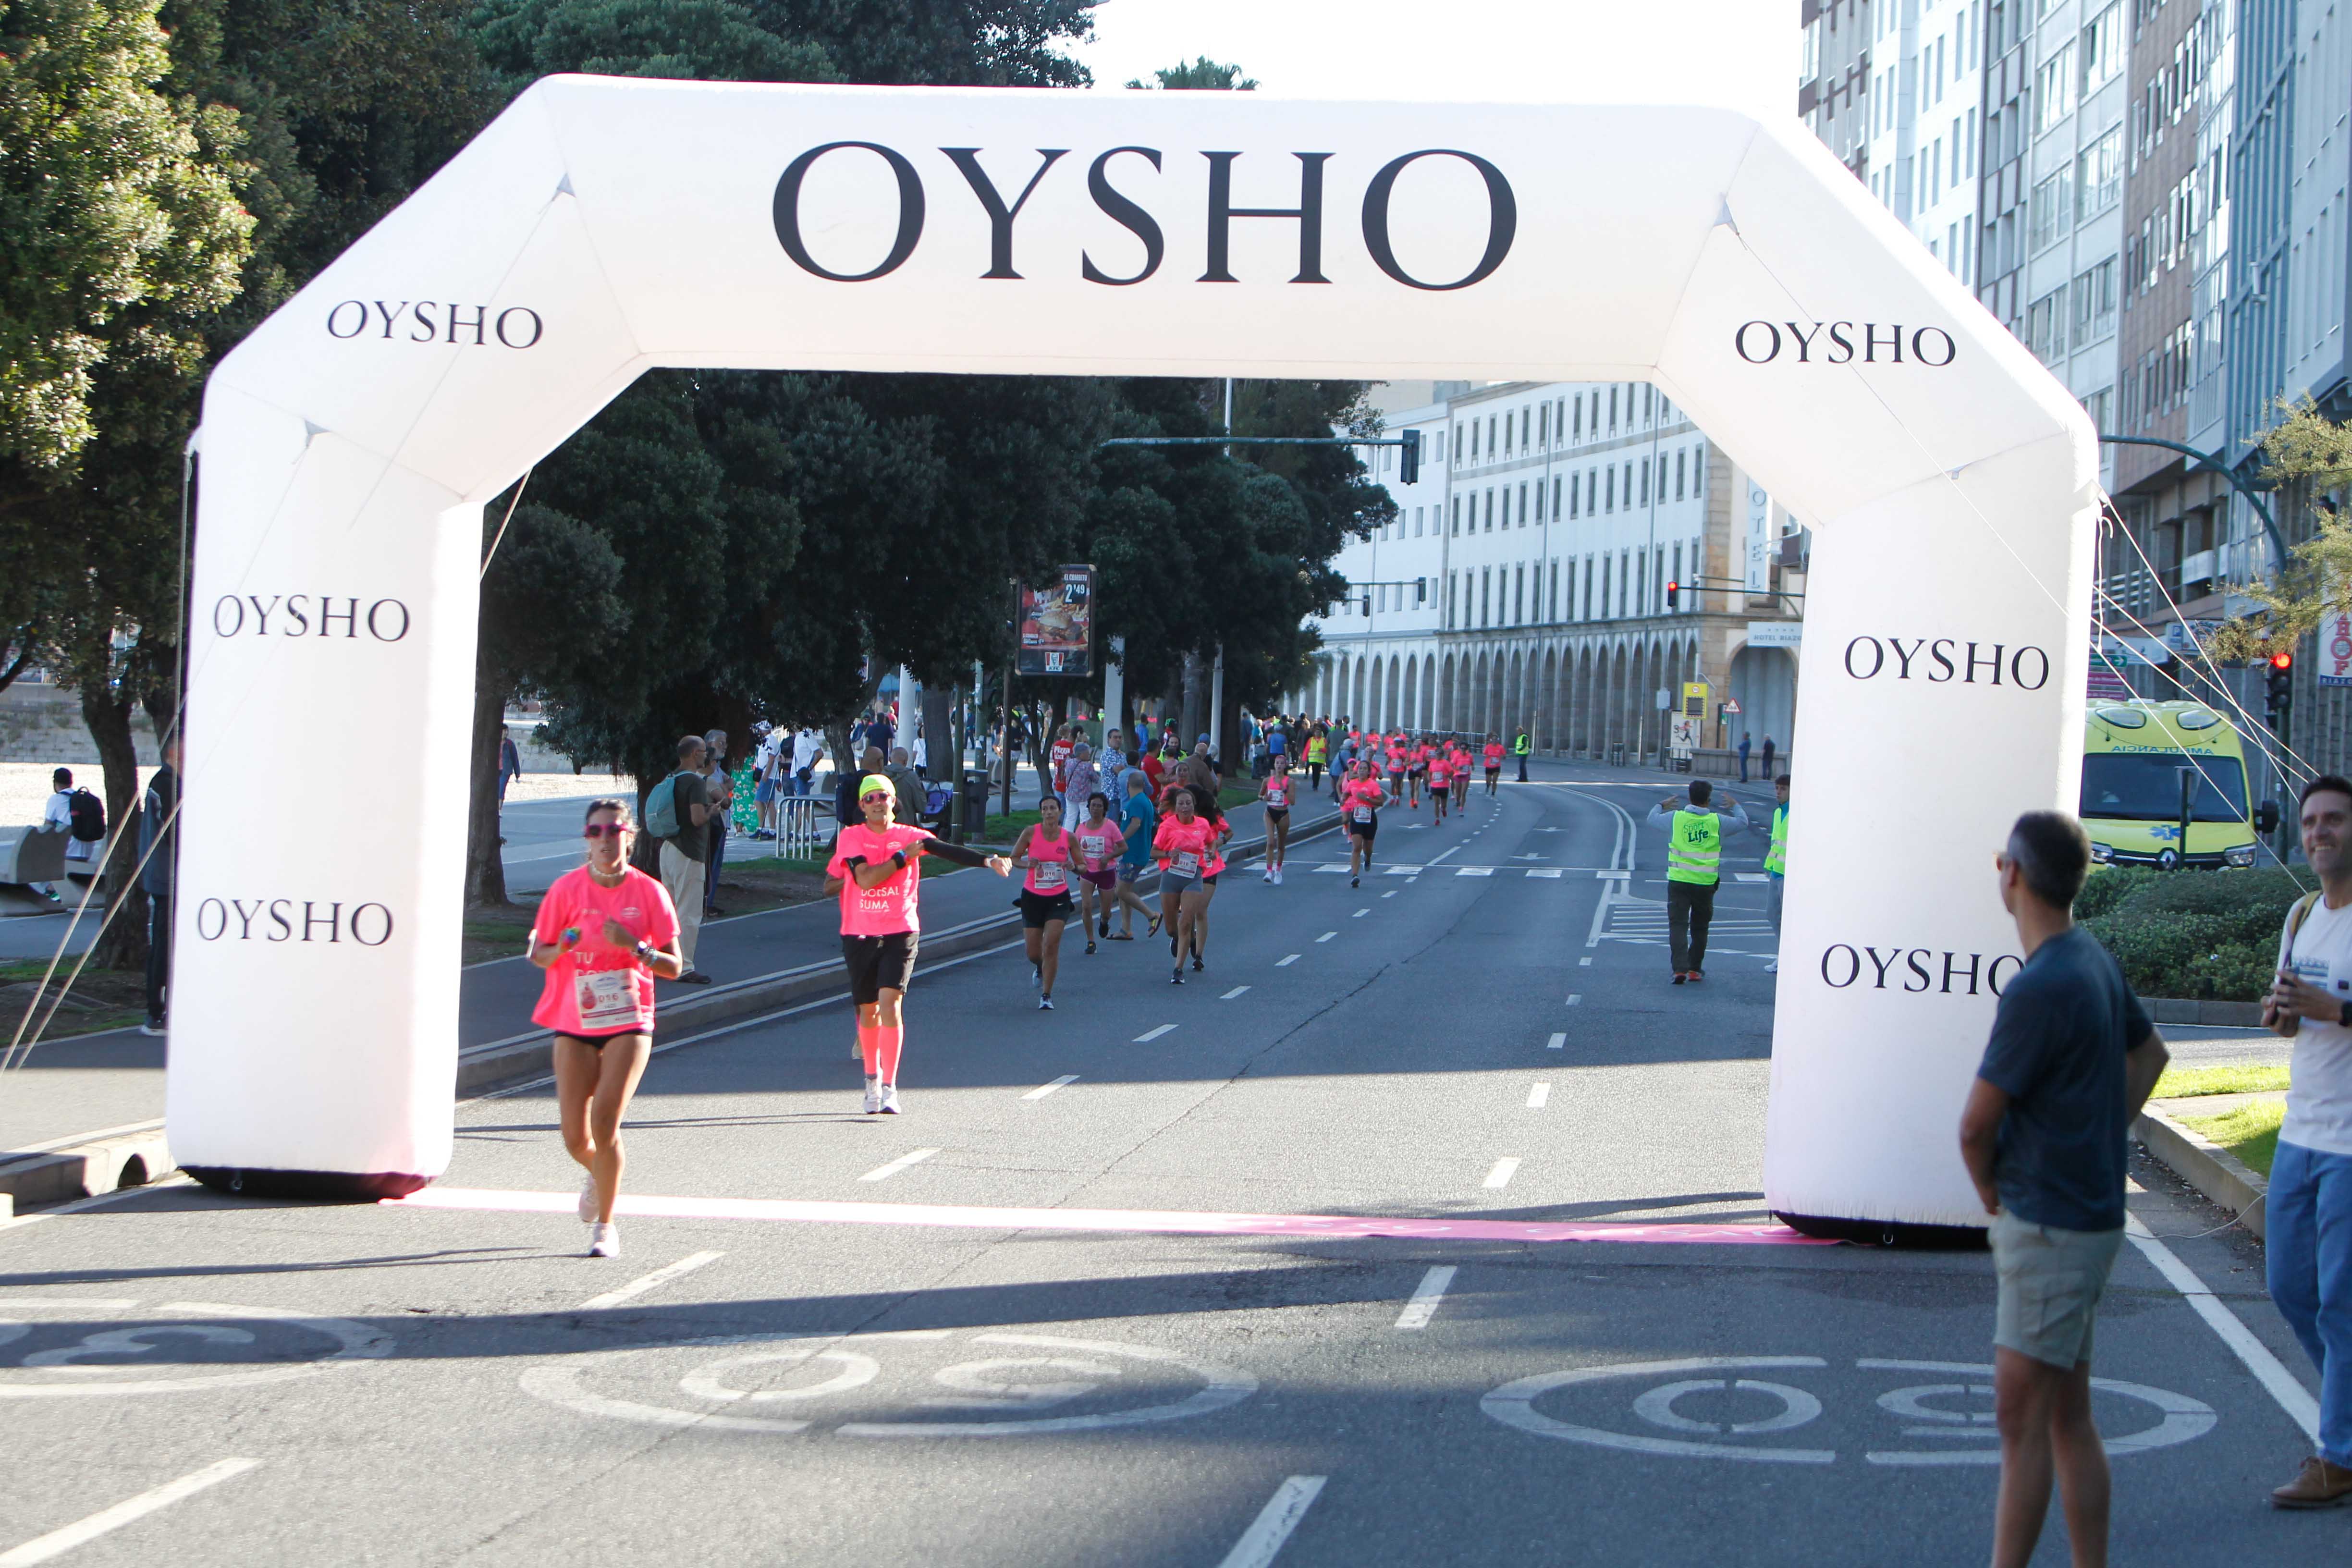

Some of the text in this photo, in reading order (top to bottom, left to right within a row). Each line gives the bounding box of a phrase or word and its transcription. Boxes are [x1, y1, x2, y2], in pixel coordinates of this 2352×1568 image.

[773, 142, 1516, 291] OYSHO
[327, 301, 543, 349] OYSHO
[1736, 321, 1956, 366] OYSHO
[1752, 488, 1767, 588] OTEL
[214, 595, 410, 642] OYSHO
[1845, 637, 2049, 690] OYSHO
[1688, 830, 1709, 843] Life
[198, 898, 393, 946] OYSHO
[576, 952, 594, 963] TU
